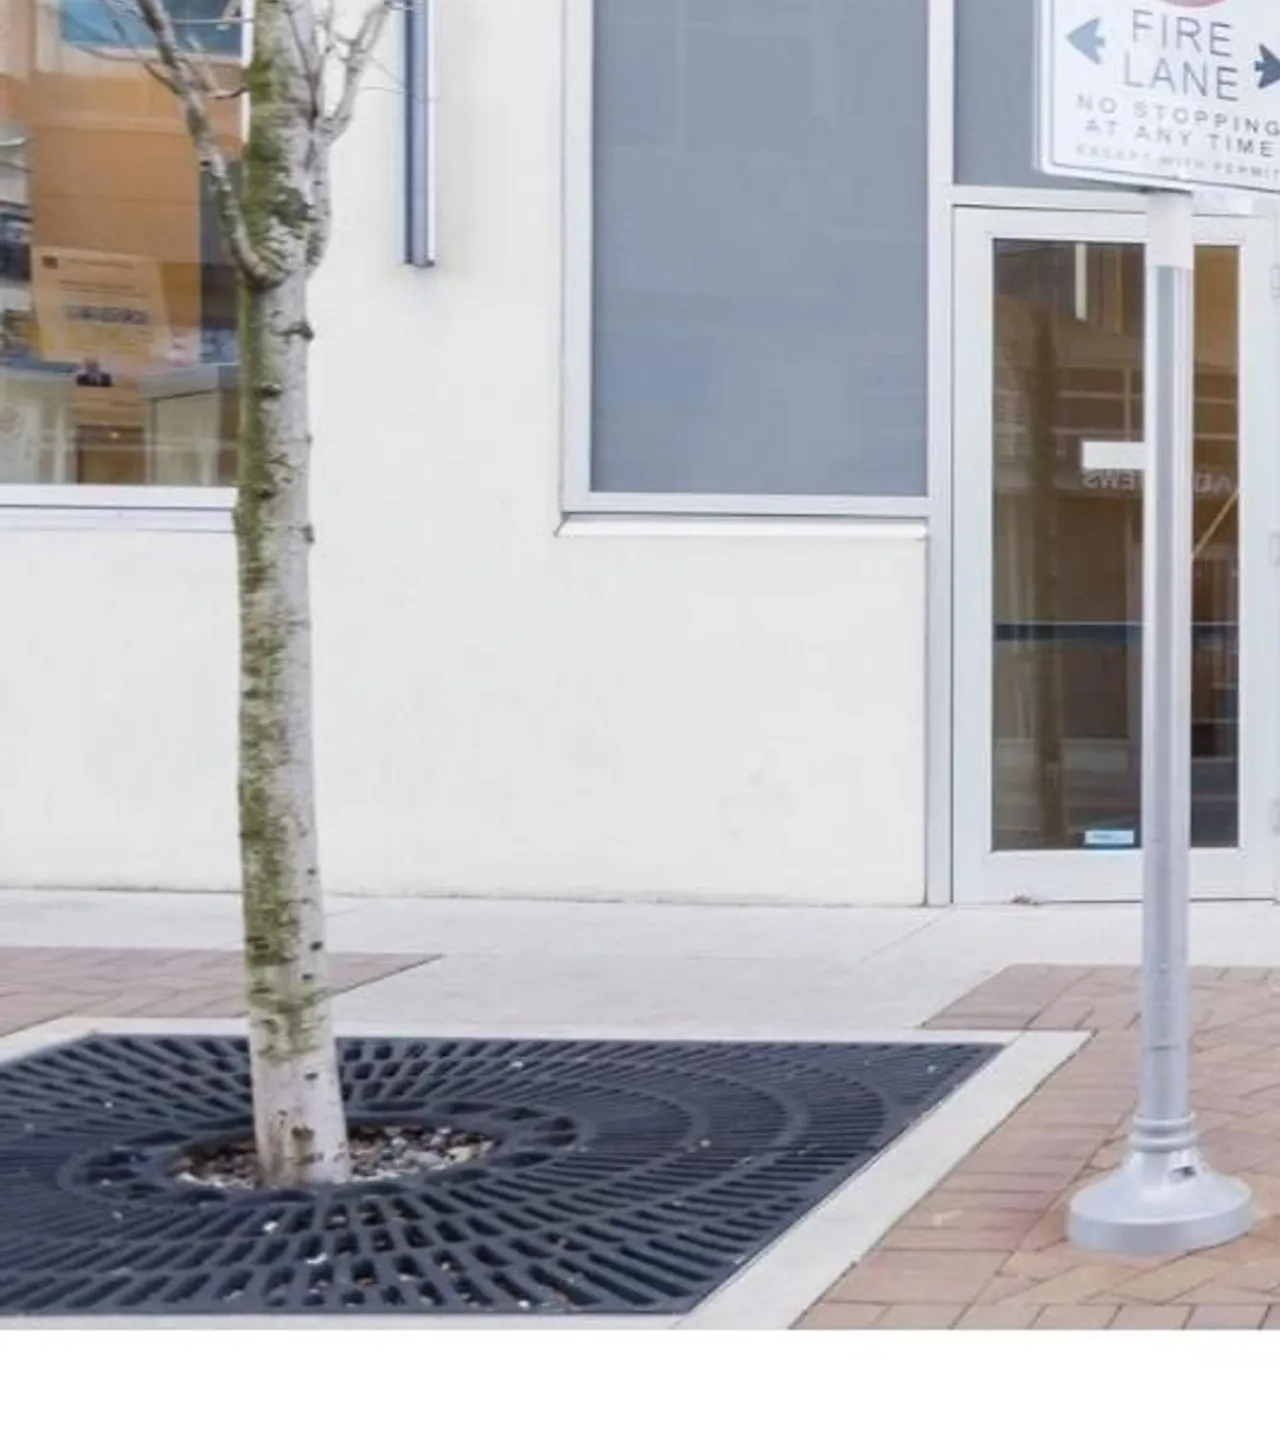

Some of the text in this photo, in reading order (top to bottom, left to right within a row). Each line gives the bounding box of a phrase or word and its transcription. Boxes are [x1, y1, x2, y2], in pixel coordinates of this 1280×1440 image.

[1132, 9, 1231, 57] FIRE
[1124, 50, 1240, 101] LANE
[1076, 94, 1117, 115] NO
[1086, 118, 1276, 158] AT ANY TIME
